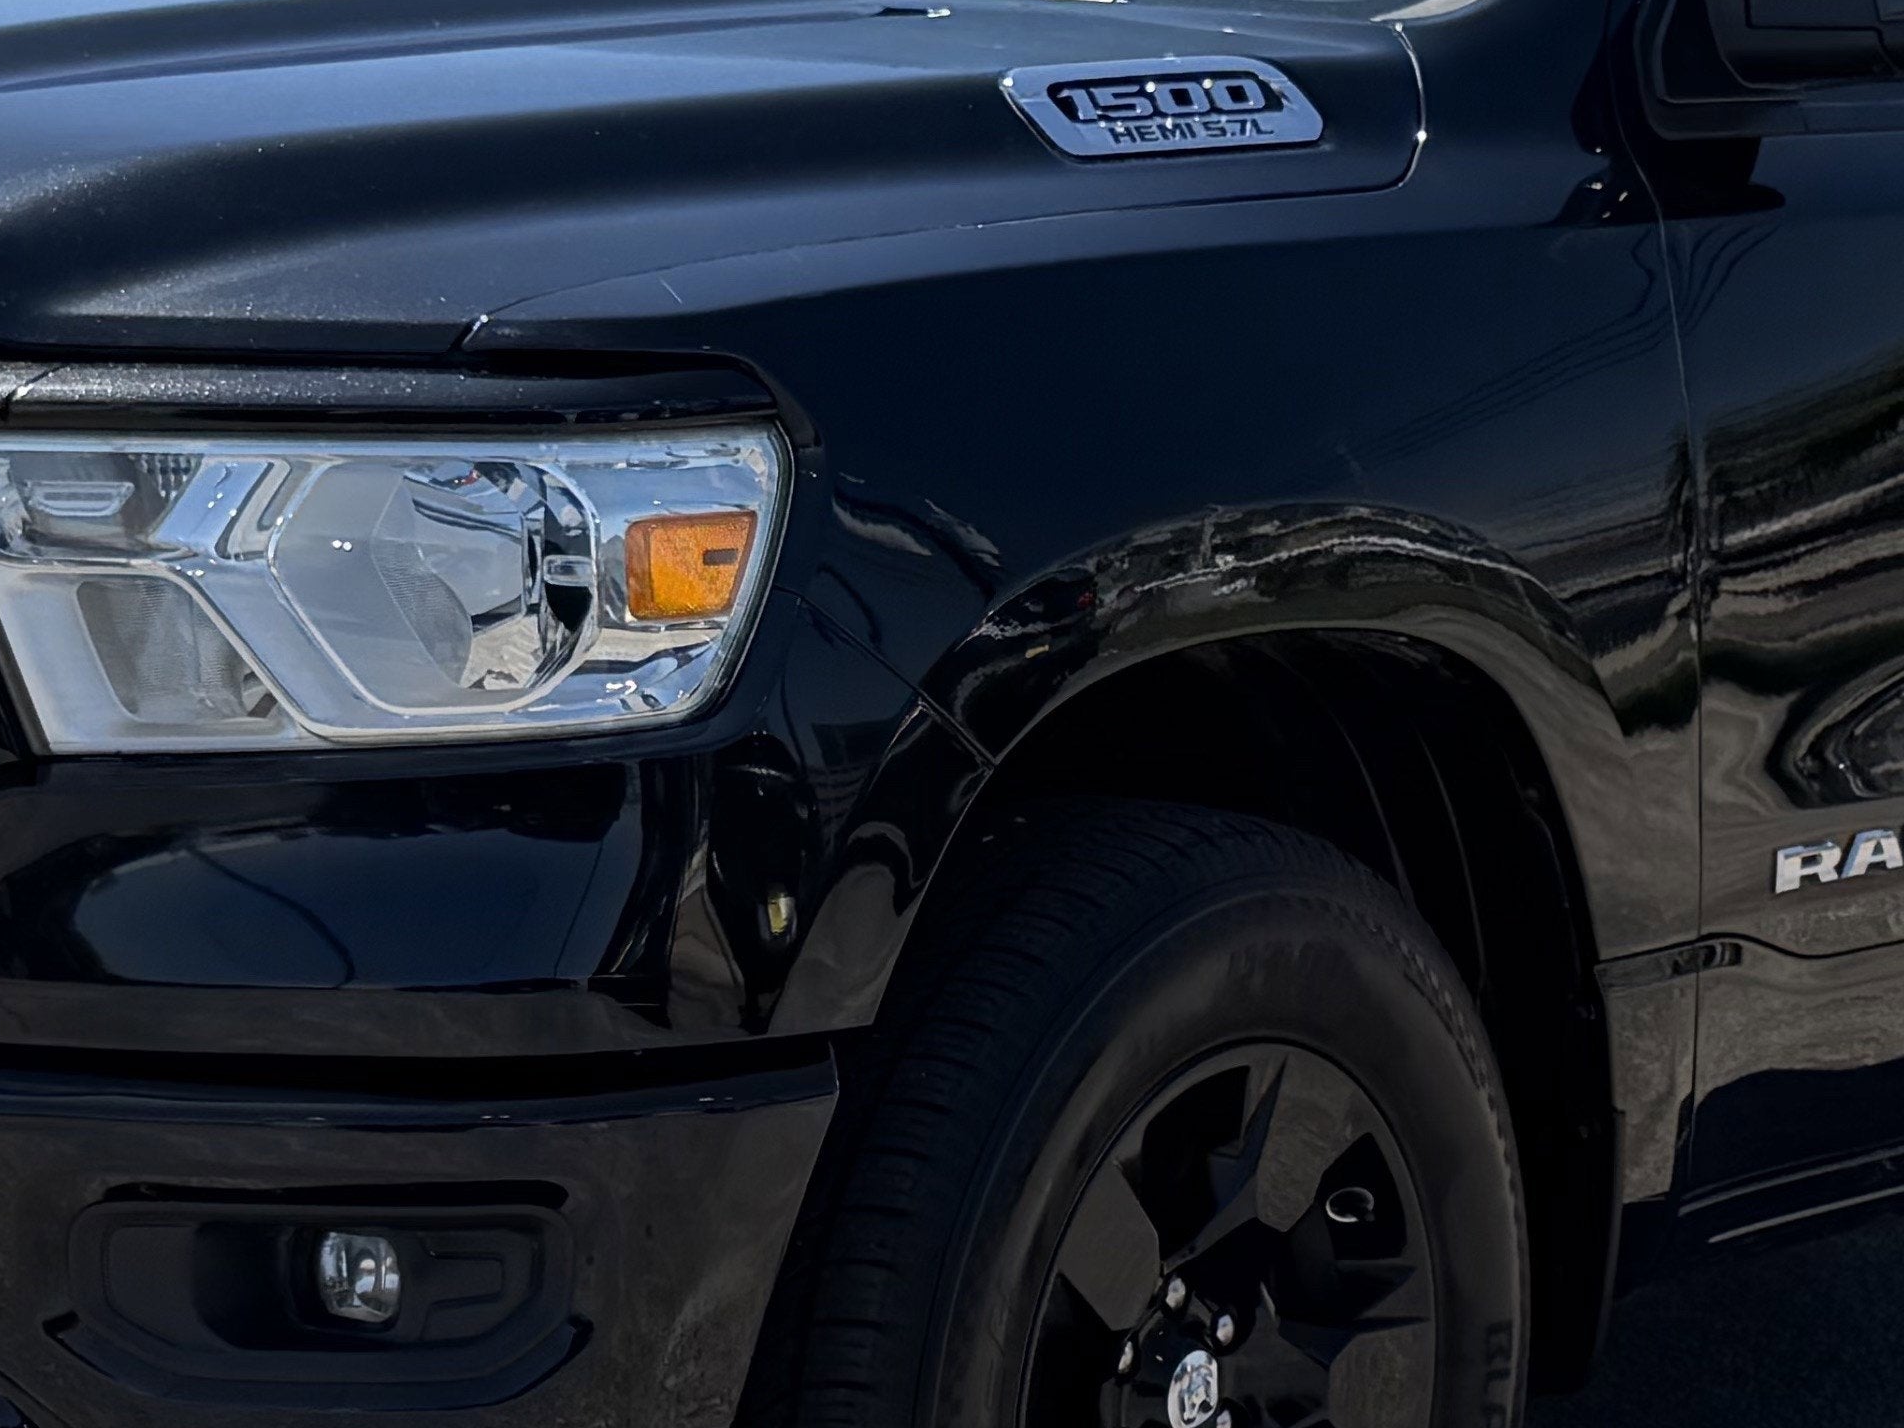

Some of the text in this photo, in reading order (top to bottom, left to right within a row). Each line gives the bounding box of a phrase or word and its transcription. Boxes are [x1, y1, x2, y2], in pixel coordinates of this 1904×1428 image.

[1057, 78, 1266, 121] 1500
[1107, 117, 1275, 145] HEMI 5.7L
